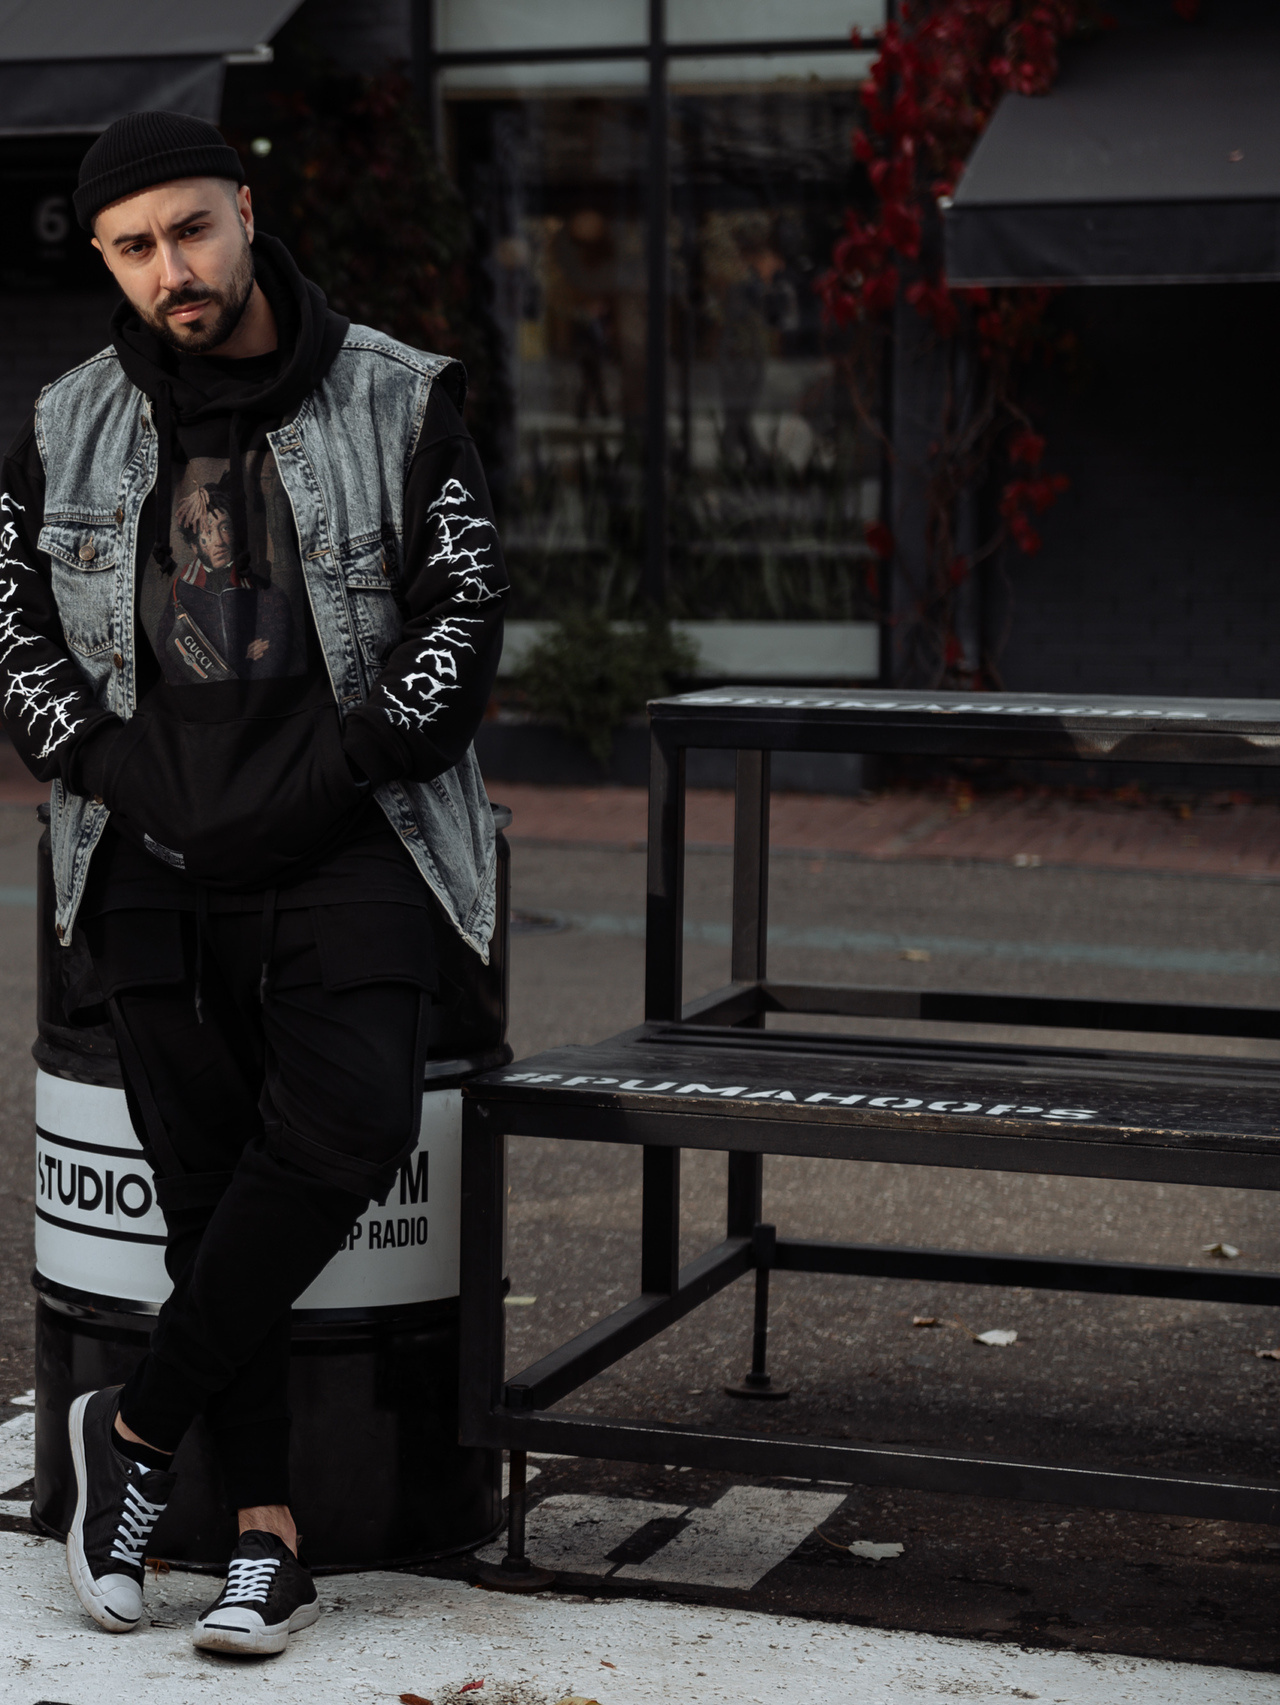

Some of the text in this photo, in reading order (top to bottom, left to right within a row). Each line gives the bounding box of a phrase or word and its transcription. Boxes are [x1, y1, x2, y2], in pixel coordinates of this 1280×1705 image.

[32, 195, 69, 243] 6
[184, 635, 213, 670] GUCCI
[501, 1072, 1098, 1120] #PUMAHOOPS
[38, 1151, 153, 1219] STUDIO
[368, 1216, 428, 1250] RADIO
